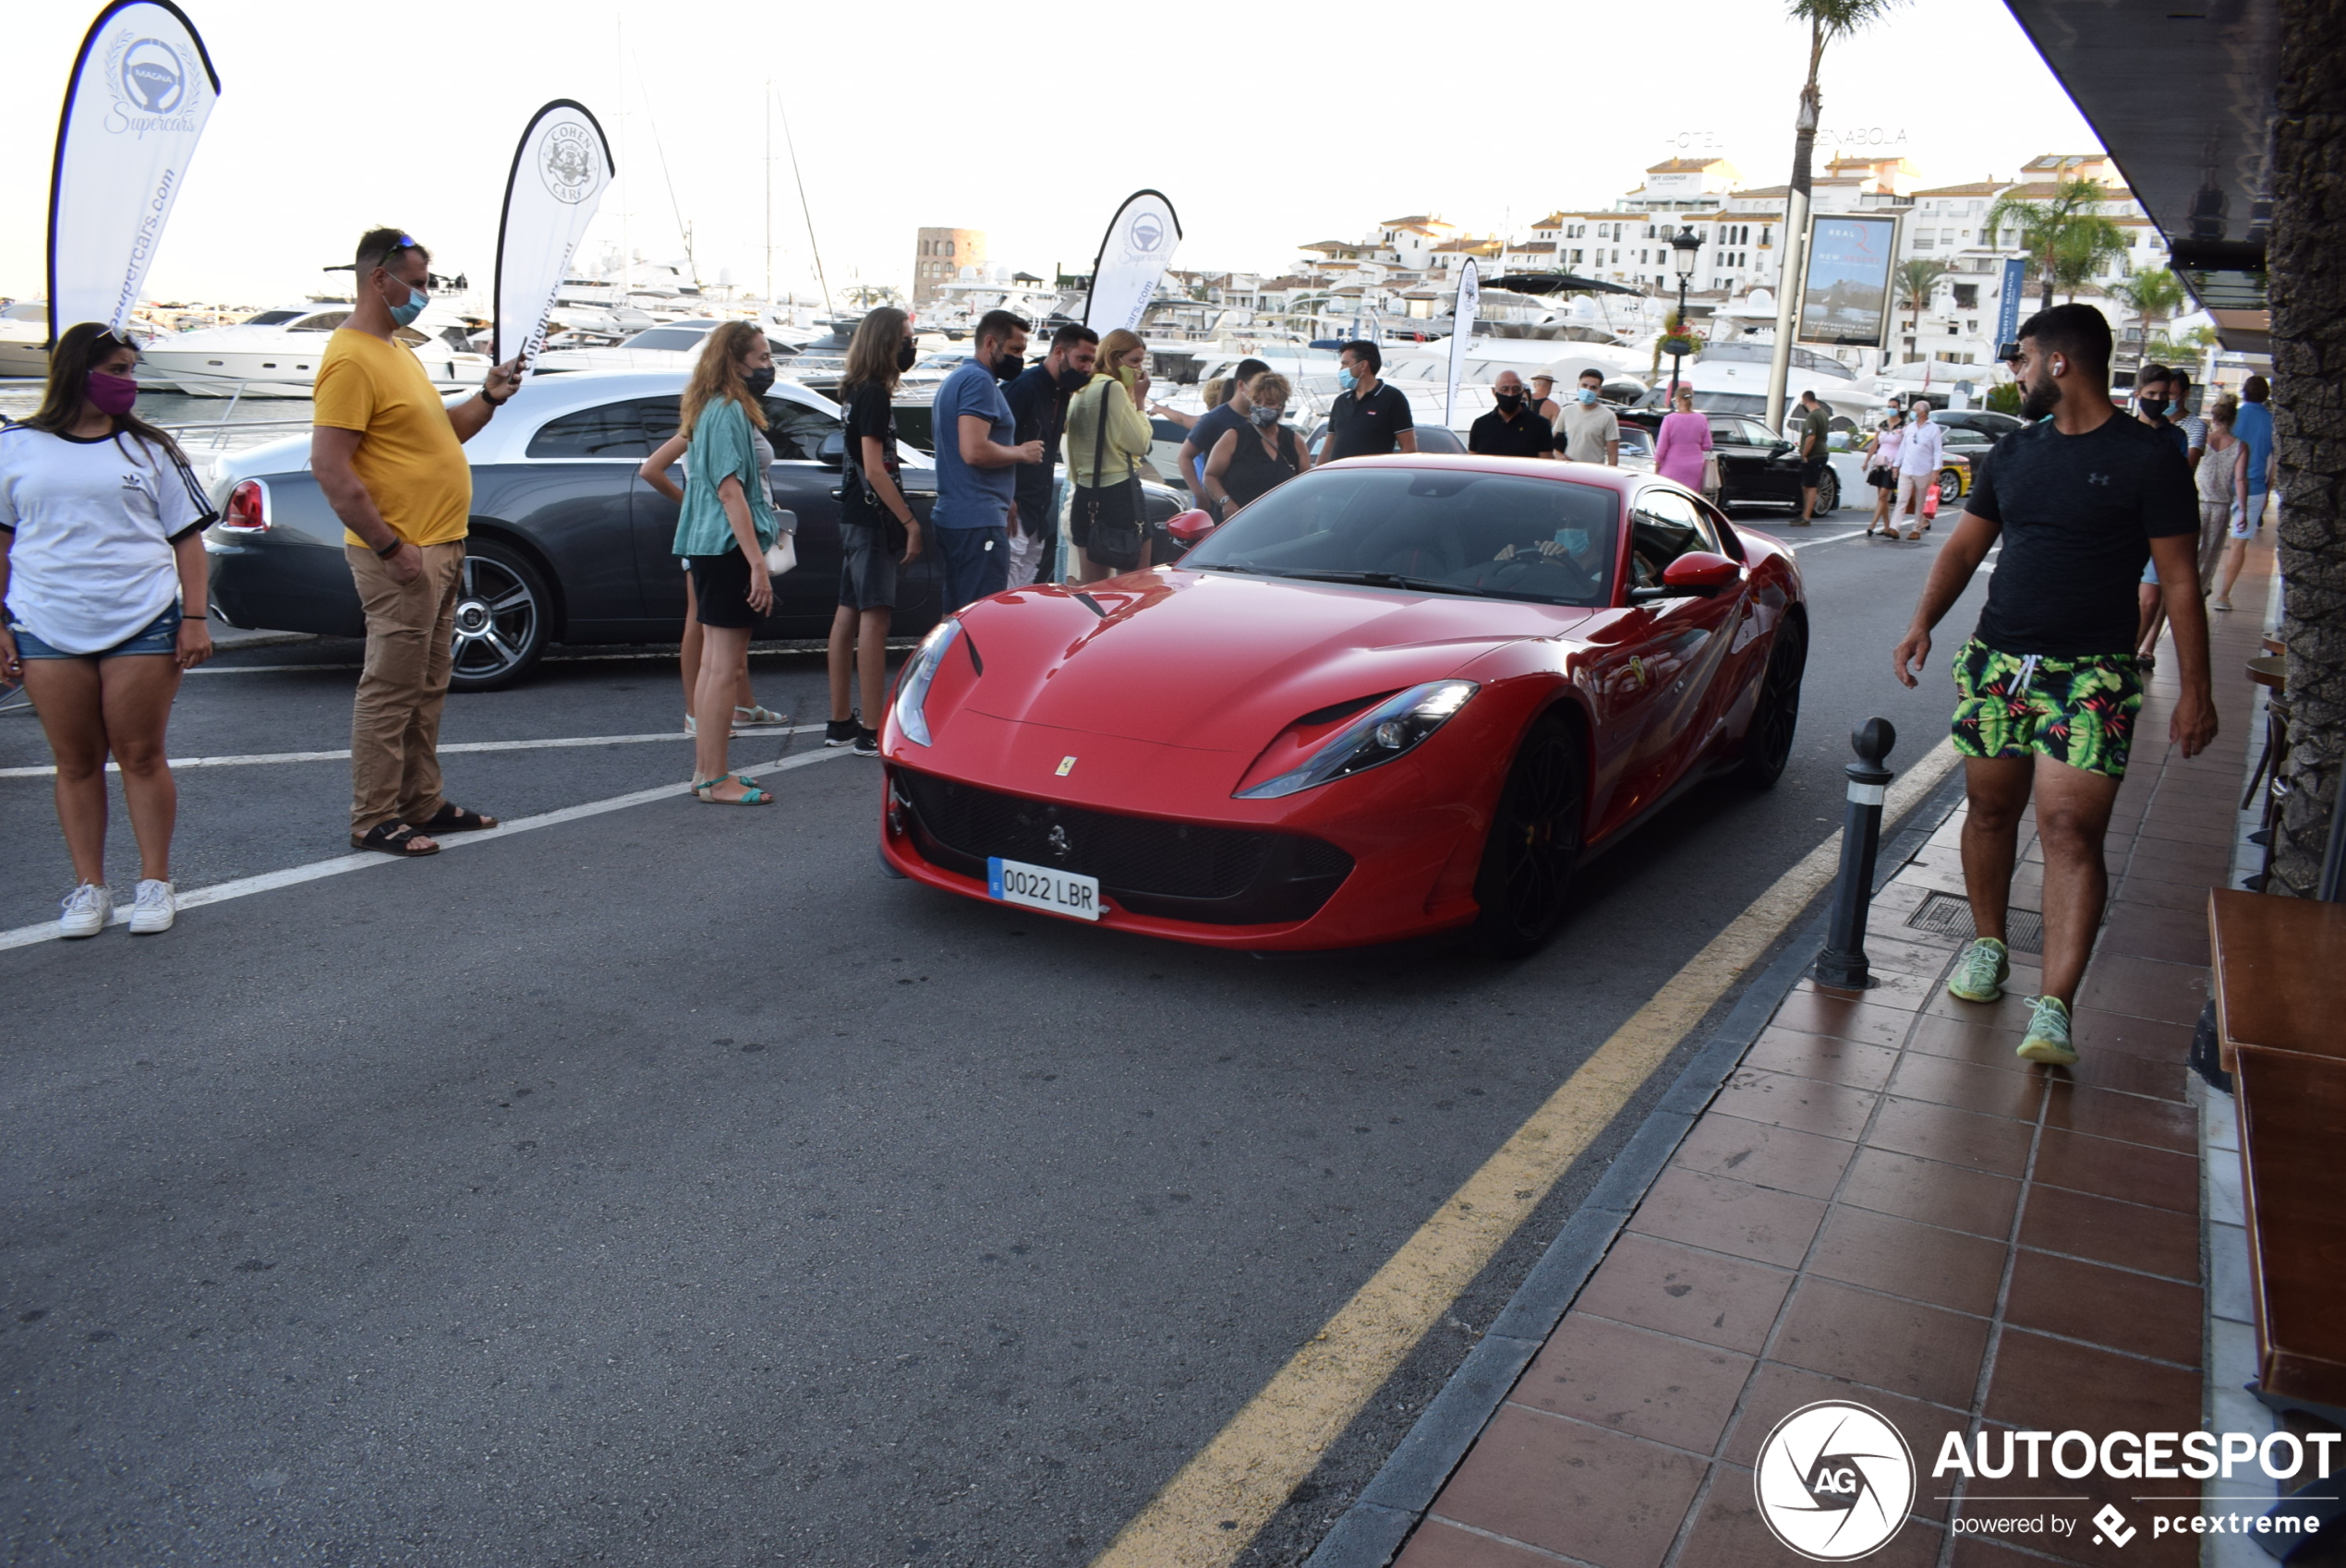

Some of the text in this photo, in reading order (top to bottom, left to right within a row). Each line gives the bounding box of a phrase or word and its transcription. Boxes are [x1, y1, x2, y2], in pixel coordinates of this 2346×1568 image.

[135, 68, 174, 84] MAGNA
[103, 101, 196, 140] Supercars
[551, 127, 593, 150] COHEN
[552, 182, 582, 200] CARS
[1828, 228, 1855, 238] REAL
[1818, 252, 1841, 261] NEW
[1004, 869, 1051, 900] 0022
[1057, 879, 1093, 911] LBR
